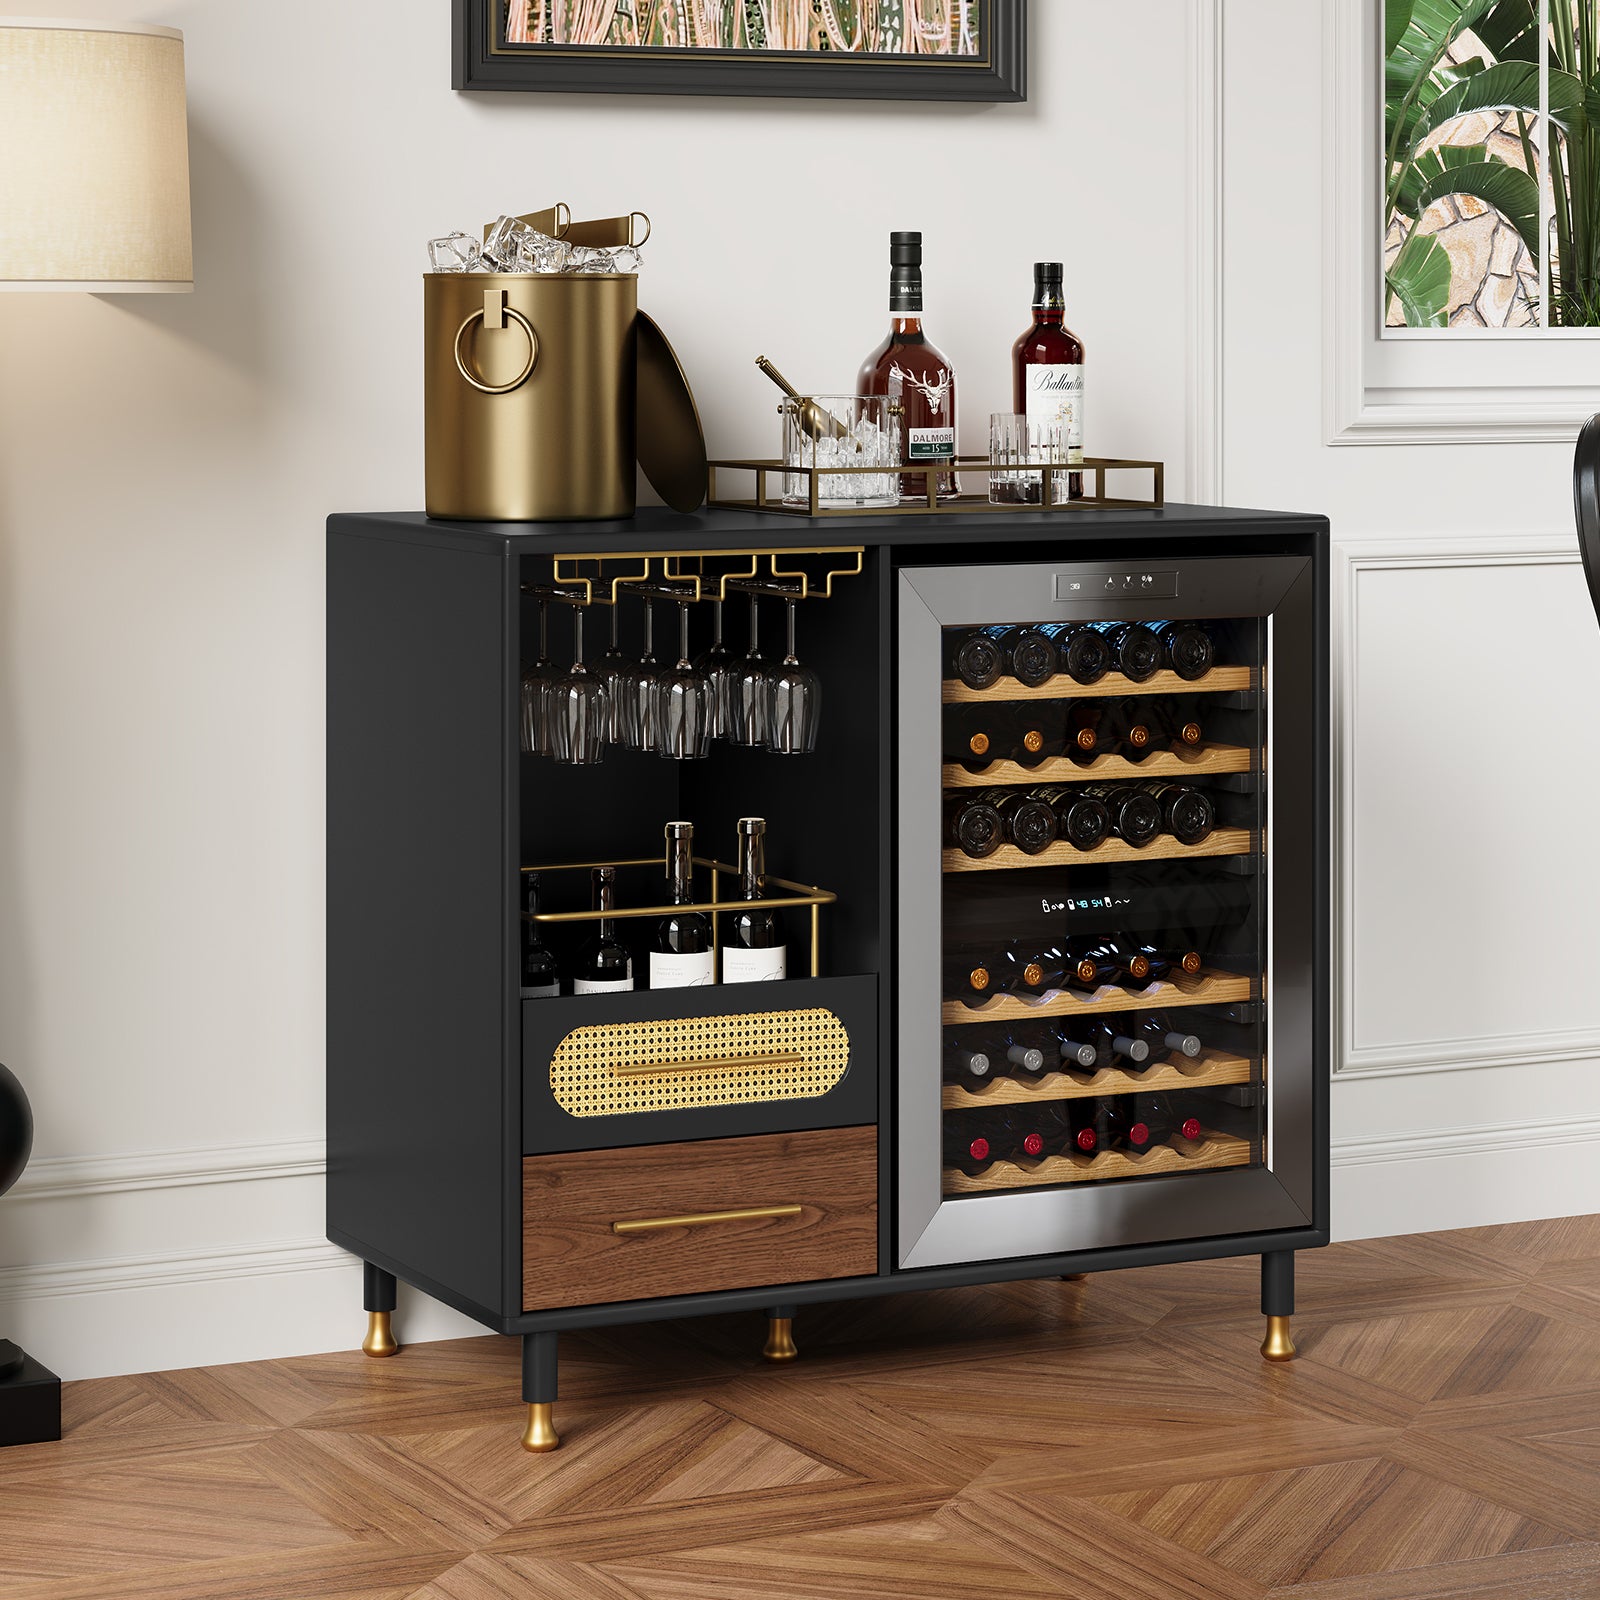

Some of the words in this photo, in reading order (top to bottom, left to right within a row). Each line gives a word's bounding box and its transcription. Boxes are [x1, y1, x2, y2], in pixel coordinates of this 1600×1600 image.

[913, 434, 952, 442] DALMORE
[932, 444, 940, 453] 15
[1076, 900, 1089, 909] 48
[1091, 899, 1104, 908] 54
